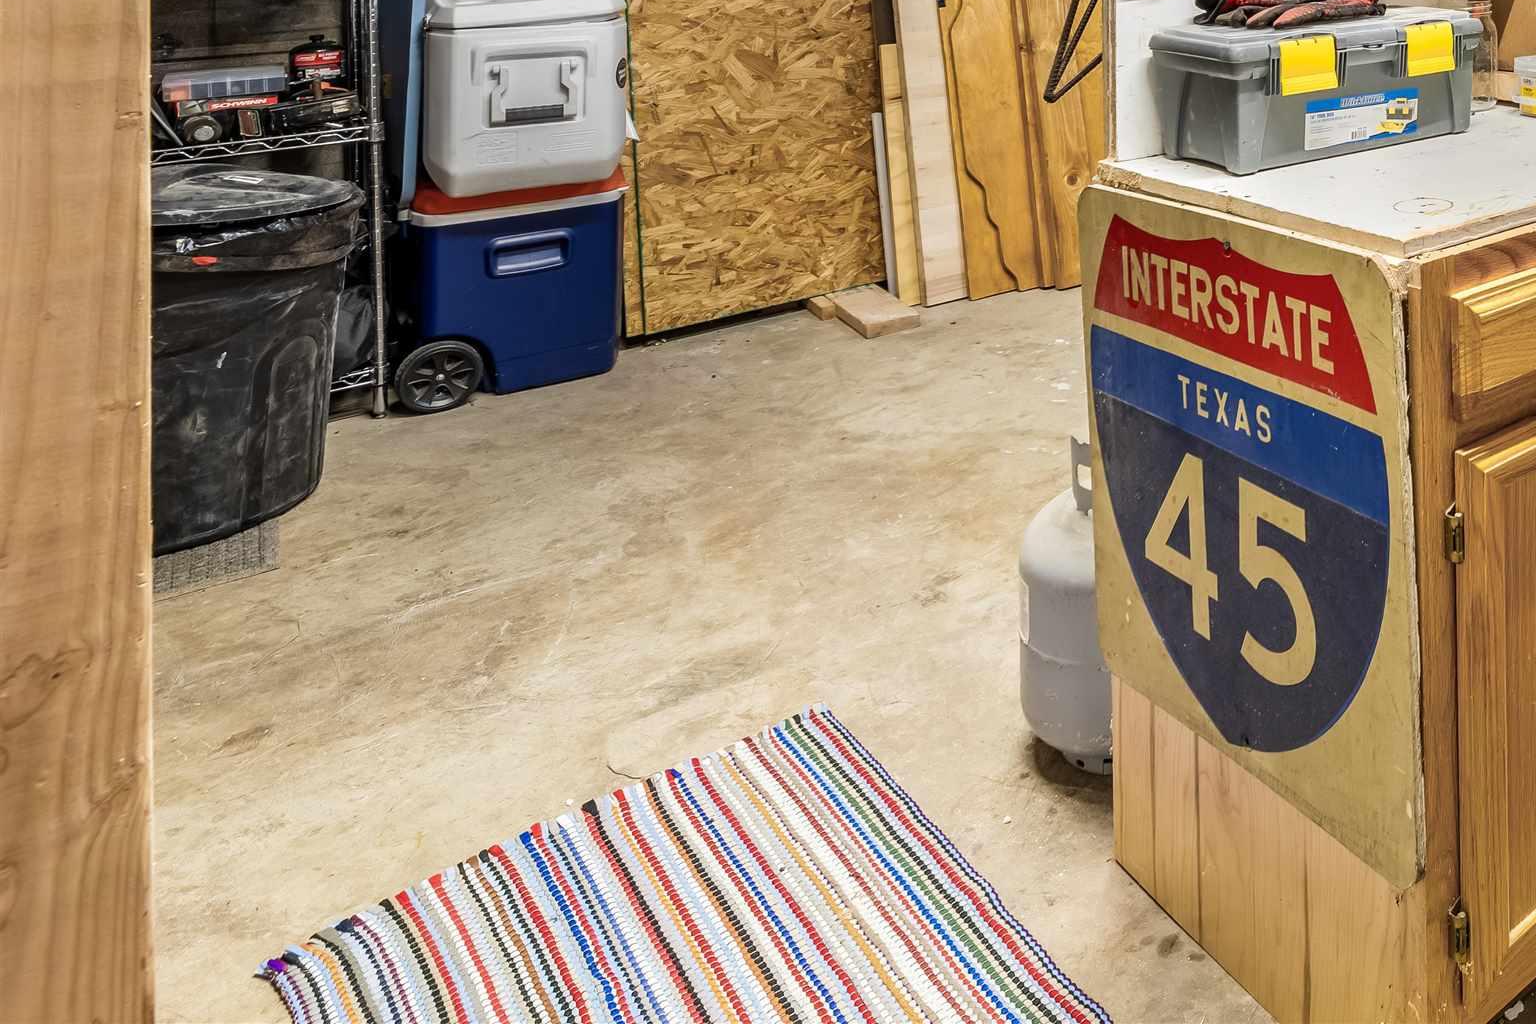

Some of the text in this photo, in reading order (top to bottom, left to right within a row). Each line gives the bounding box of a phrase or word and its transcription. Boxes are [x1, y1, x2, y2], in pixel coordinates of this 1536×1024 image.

[210, 97, 268, 110] SCHWINN
[1120, 245, 1335, 375] INTERSTATE
[1176, 374, 1274, 444] TEXAS
[1144, 451, 1317, 687] 45
